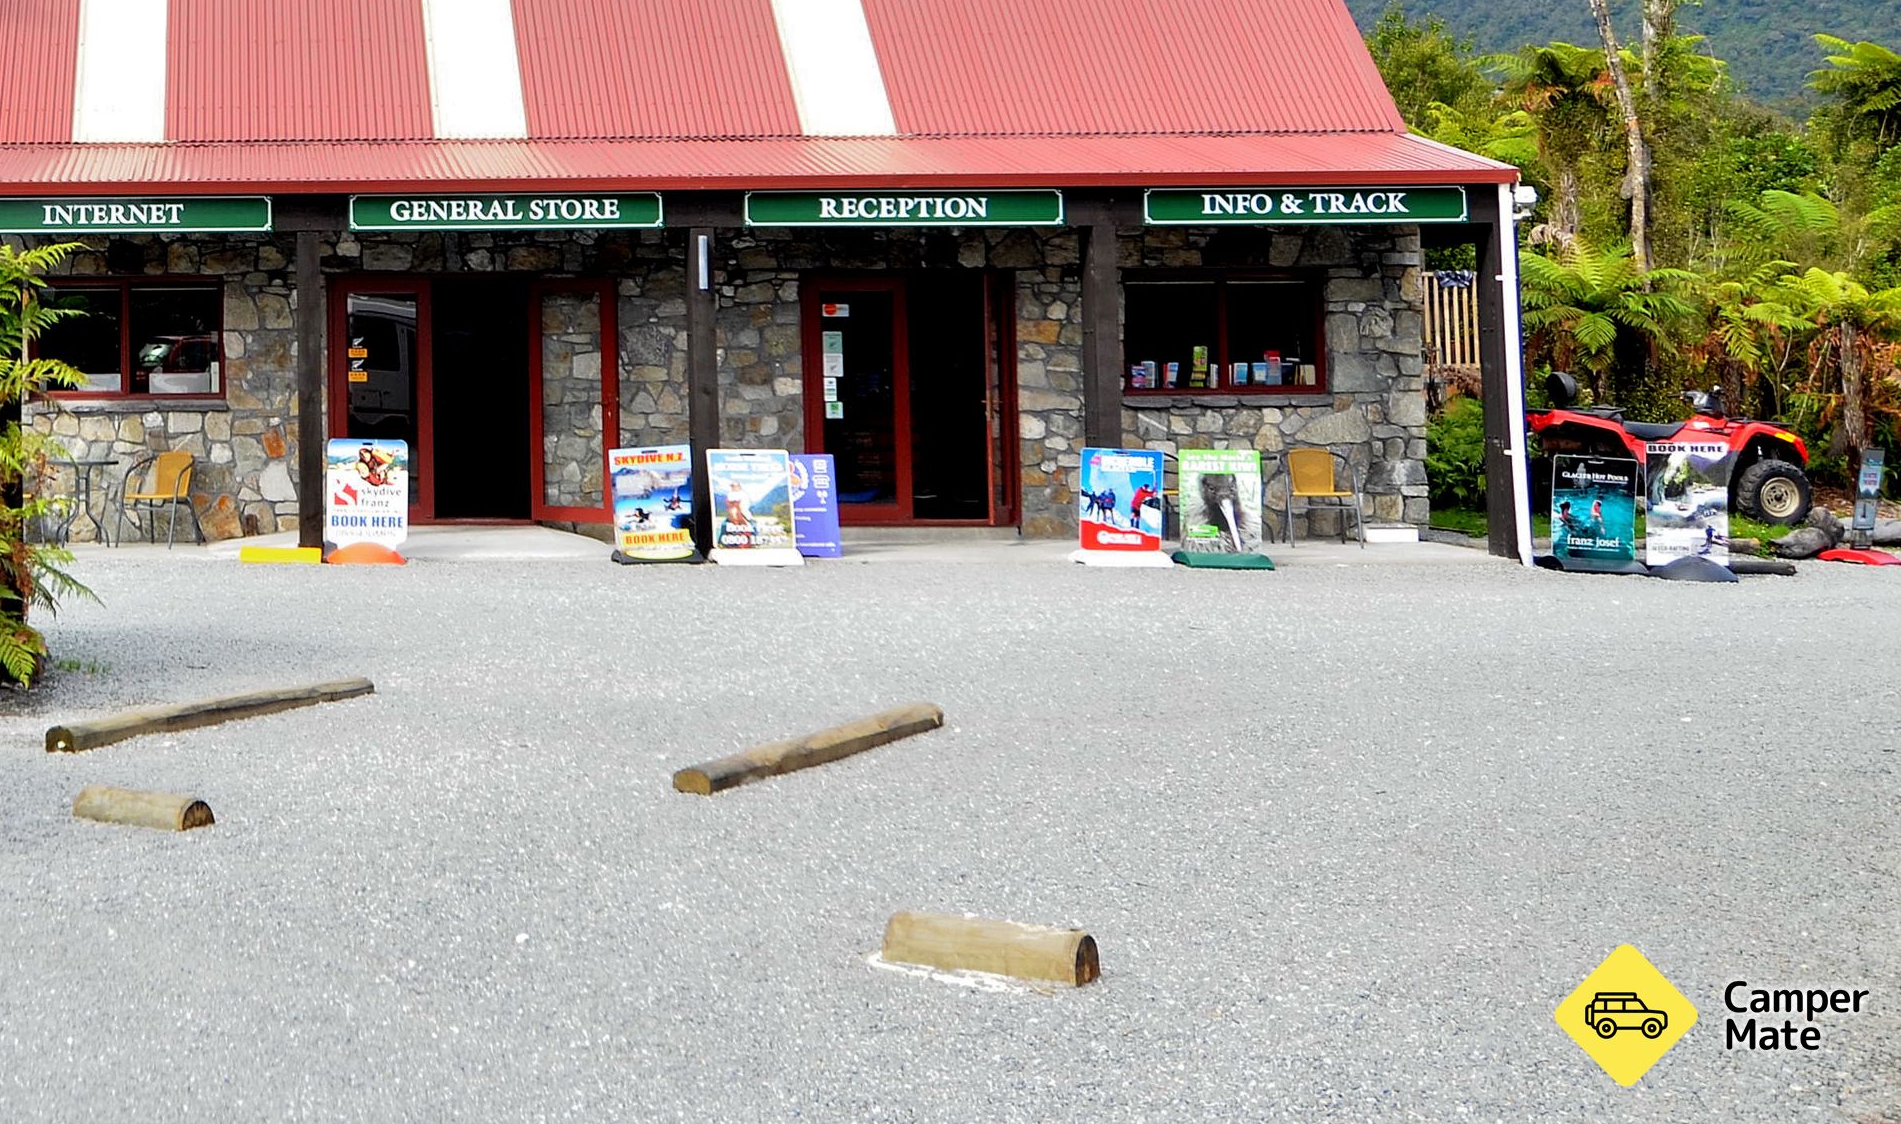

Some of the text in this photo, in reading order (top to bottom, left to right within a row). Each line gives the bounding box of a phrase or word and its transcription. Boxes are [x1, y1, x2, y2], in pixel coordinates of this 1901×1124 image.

[819, 197, 988, 218] RECEPTION
[1201, 192, 1410, 214] INFO & TRACK
[42, 203, 185, 225] INTERNET
[390, 199, 620, 221] GENERAL STORE
[1690, 445, 1724, 453] HERE
[614, 454, 664, 466] SKYDIVE
[361, 487, 402, 497] skydive
[361, 498, 390, 508] franz
[331, 515, 404, 528] BOOK HERE
[625, 532, 685, 545] BOOK HERE
[1567, 533, 1620, 548] franz josef
